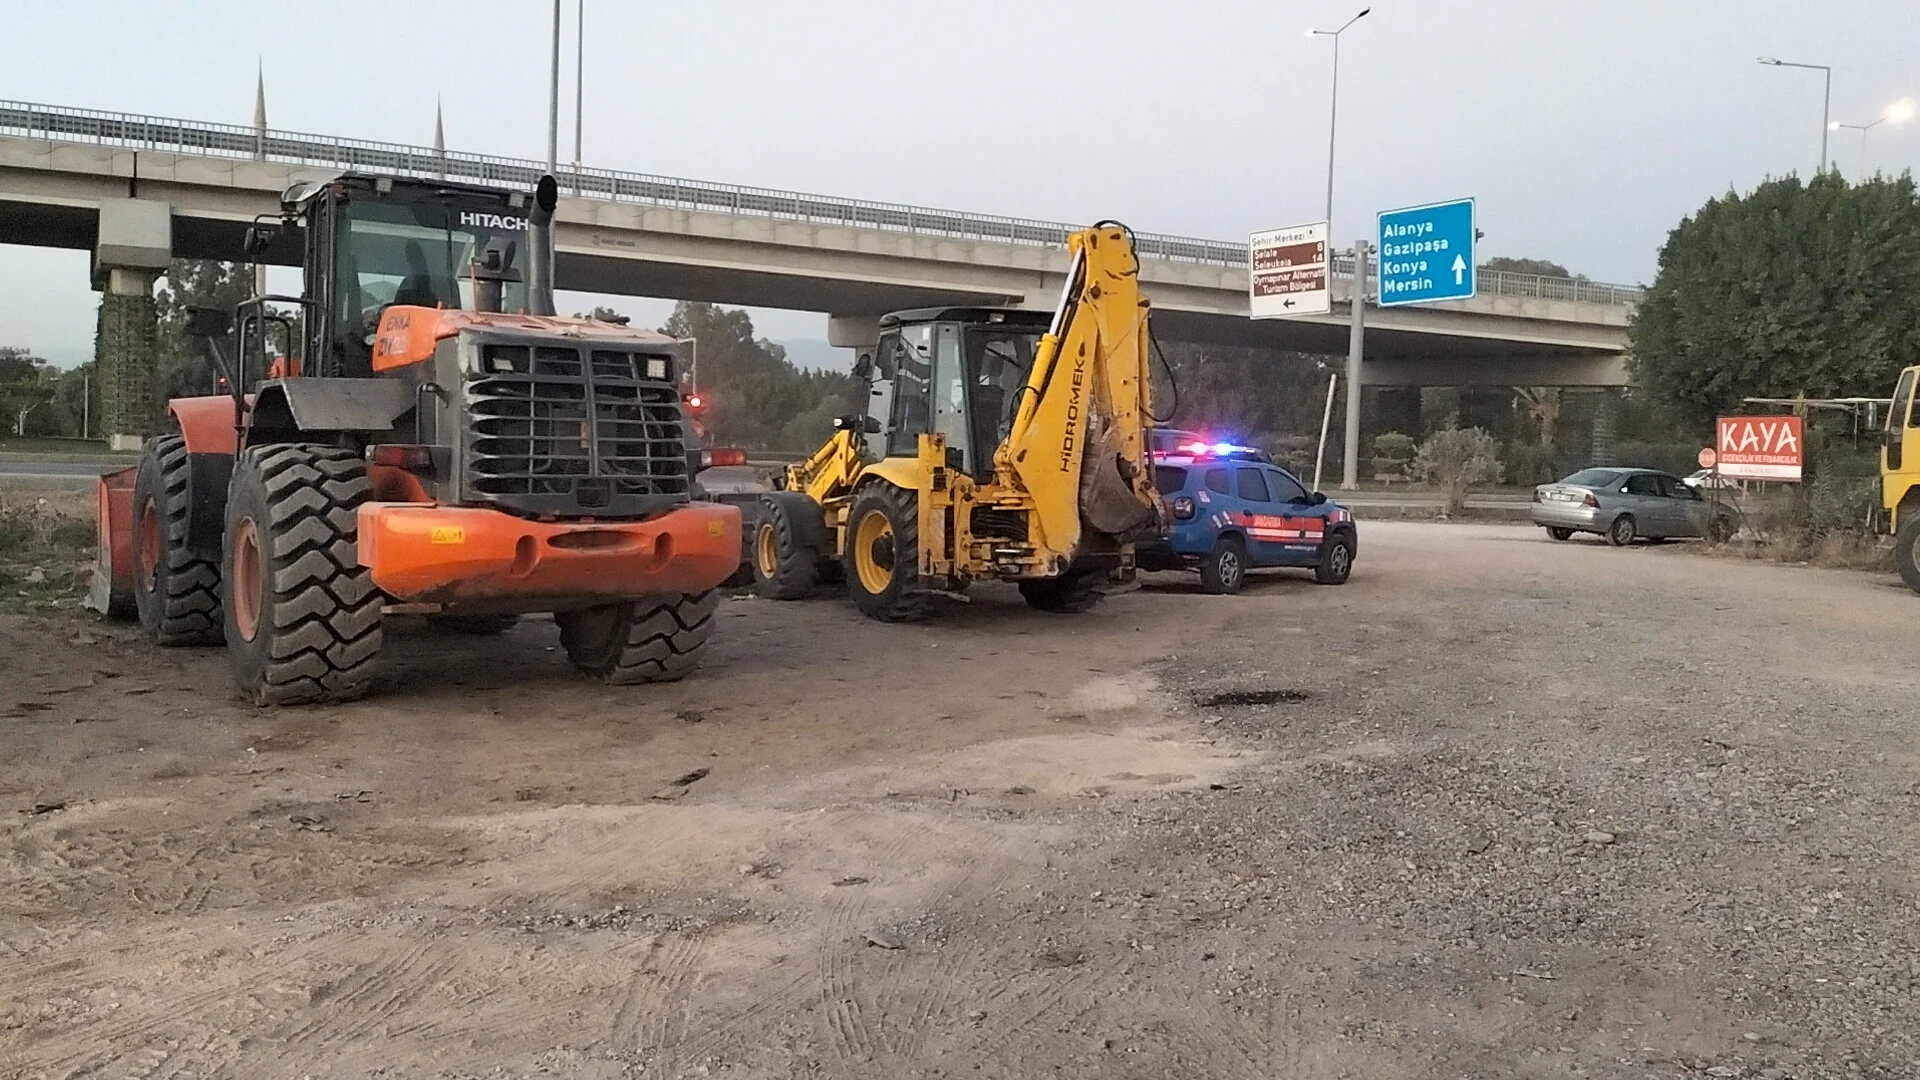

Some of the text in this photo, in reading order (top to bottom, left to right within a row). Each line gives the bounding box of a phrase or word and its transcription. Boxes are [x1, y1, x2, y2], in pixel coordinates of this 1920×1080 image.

[460, 211, 529, 231] HITACH
[1274, 232, 1305, 243] Merkezi
[1384, 221, 1433, 239] Alanya
[1316, 242, 1323, 252] 8
[1384, 239, 1449, 257] Gazipaşa
[1312, 253, 1323, 263] 14
[1384, 260, 1428, 276] Konya
[1262, 281, 1317, 294] Turizm Bölgesi
[1384, 277, 1433, 293] Mersin
[1722, 421, 1798, 453] KAYA
